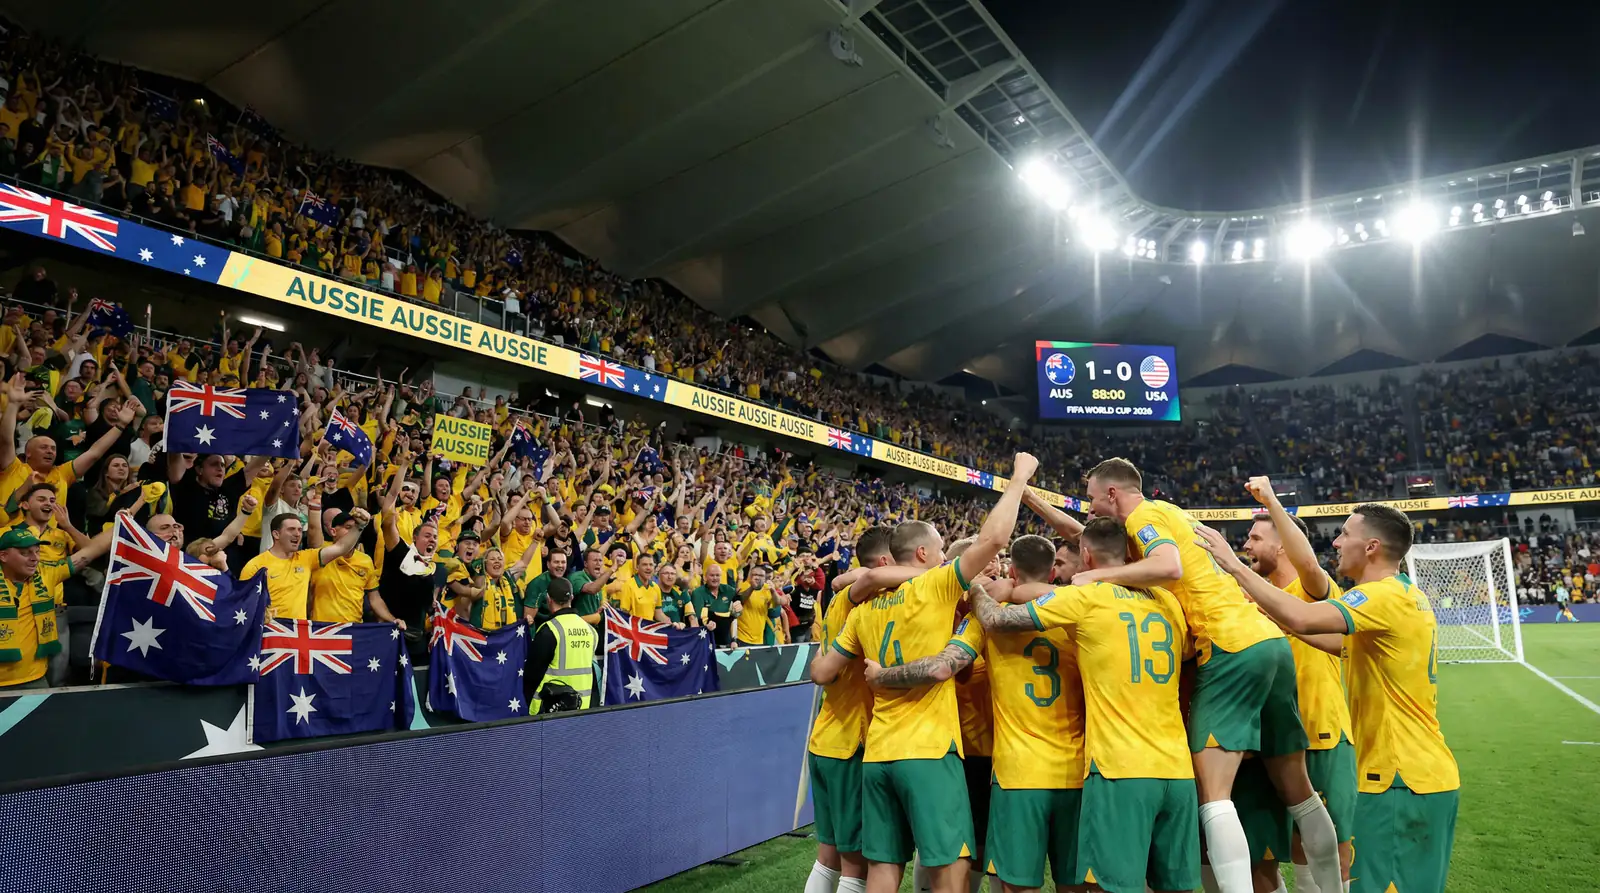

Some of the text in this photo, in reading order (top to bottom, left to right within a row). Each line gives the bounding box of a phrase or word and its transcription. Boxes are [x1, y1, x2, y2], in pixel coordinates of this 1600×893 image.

[286, 277, 548, 366] AUSSIE AUSSIE AUSSIE
[1085, 360, 1096, 380] 1
[1116, 361, 1132, 381] 0
[1049, 388, 1169, 402] AUS 88:00 USA
[691, 391, 814, 438] AUSSIE AUSSIE AUSSIE
[1066, 405, 1153, 415] FIFA WORLD CUP 2026
[436, 419, 491, 441] AUSSIE
[433, 437, 488, 458] AUSSIE
[886, 447, 958, 477] AUSSIE AUSSIE AUSSIE
[1531, 491, 1576, 502] AUSSIE
[1206, 511, 1238, 519] AUSSIE
[1315, 505, 1350, 515] AUSSIE
[1393, 500, 1431, 510] AUSSIE
[879, 620, 904, 668] 4
[1119, 612, 1175, 684] 13
[1023, 636, 1061, 708] 3
